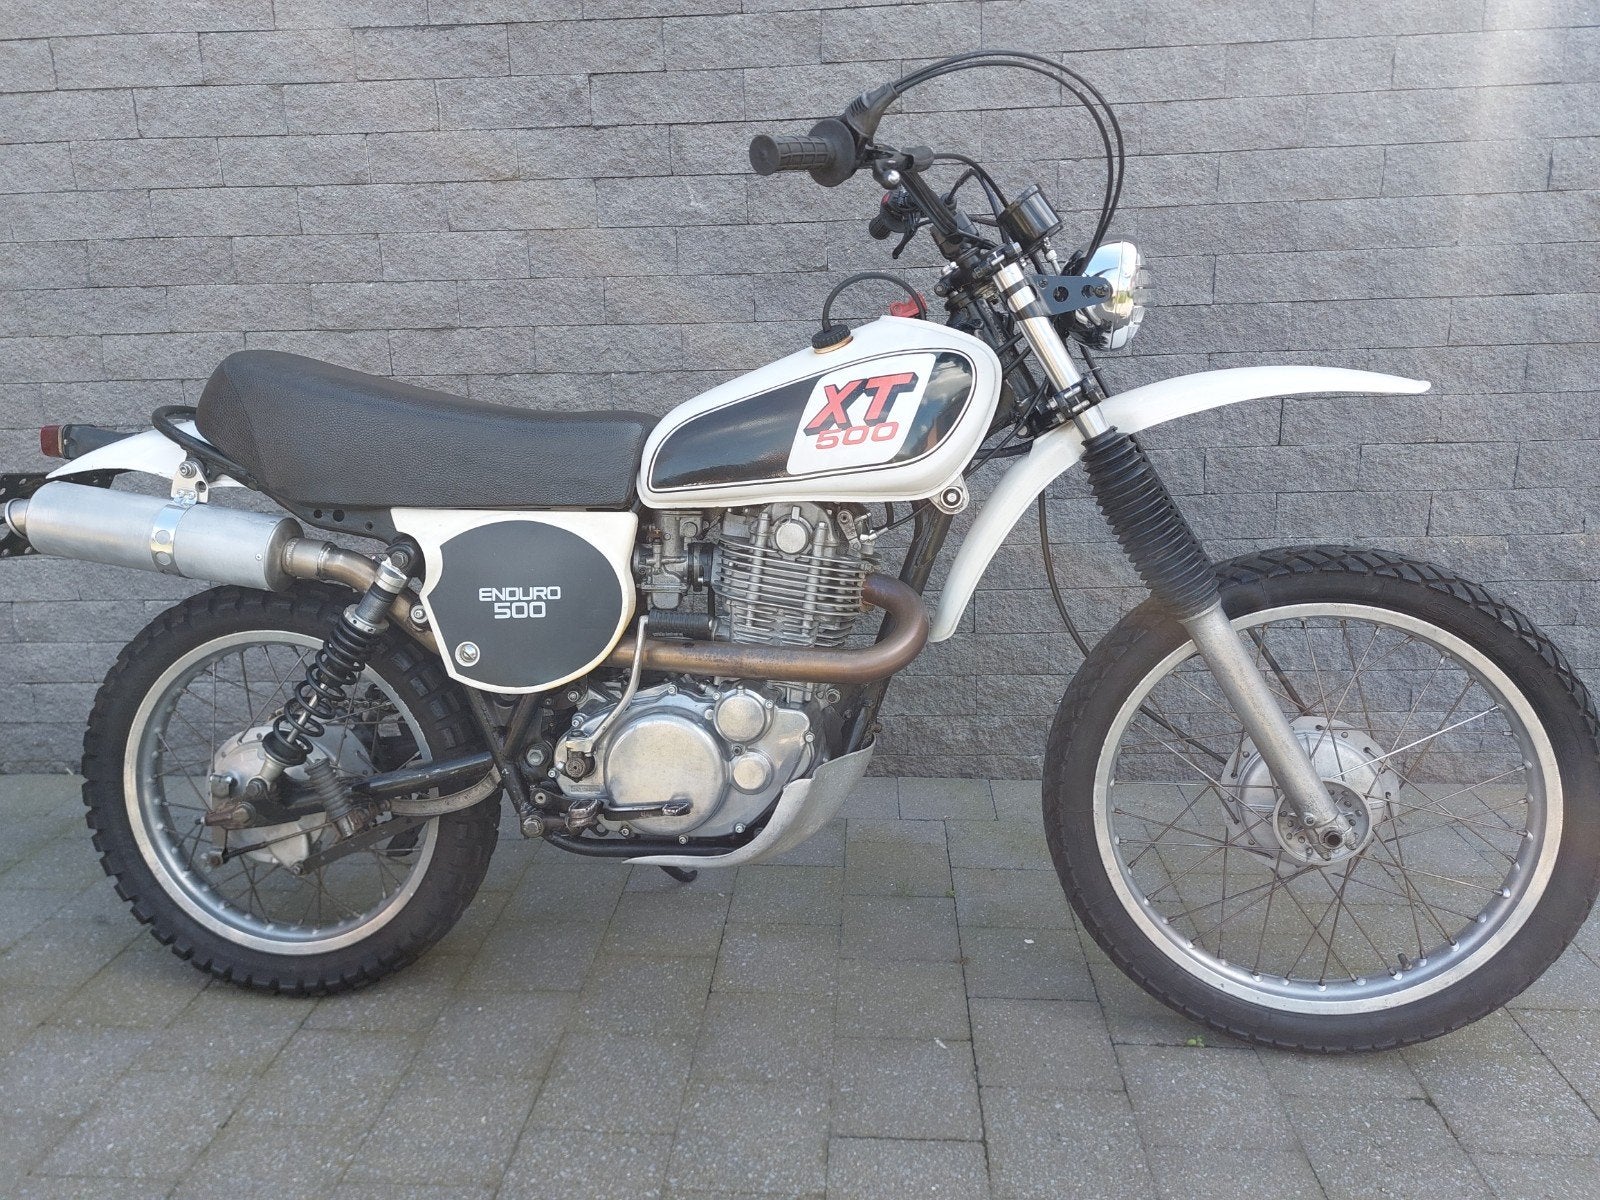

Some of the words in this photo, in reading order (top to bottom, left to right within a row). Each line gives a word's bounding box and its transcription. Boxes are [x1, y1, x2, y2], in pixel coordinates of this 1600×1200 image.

[804, 372, 918, 436] XT
[815, 421, 900, 450] 500
[478, 586, 562, 602] ENDURO
[493, 601, 547, 619] 500
